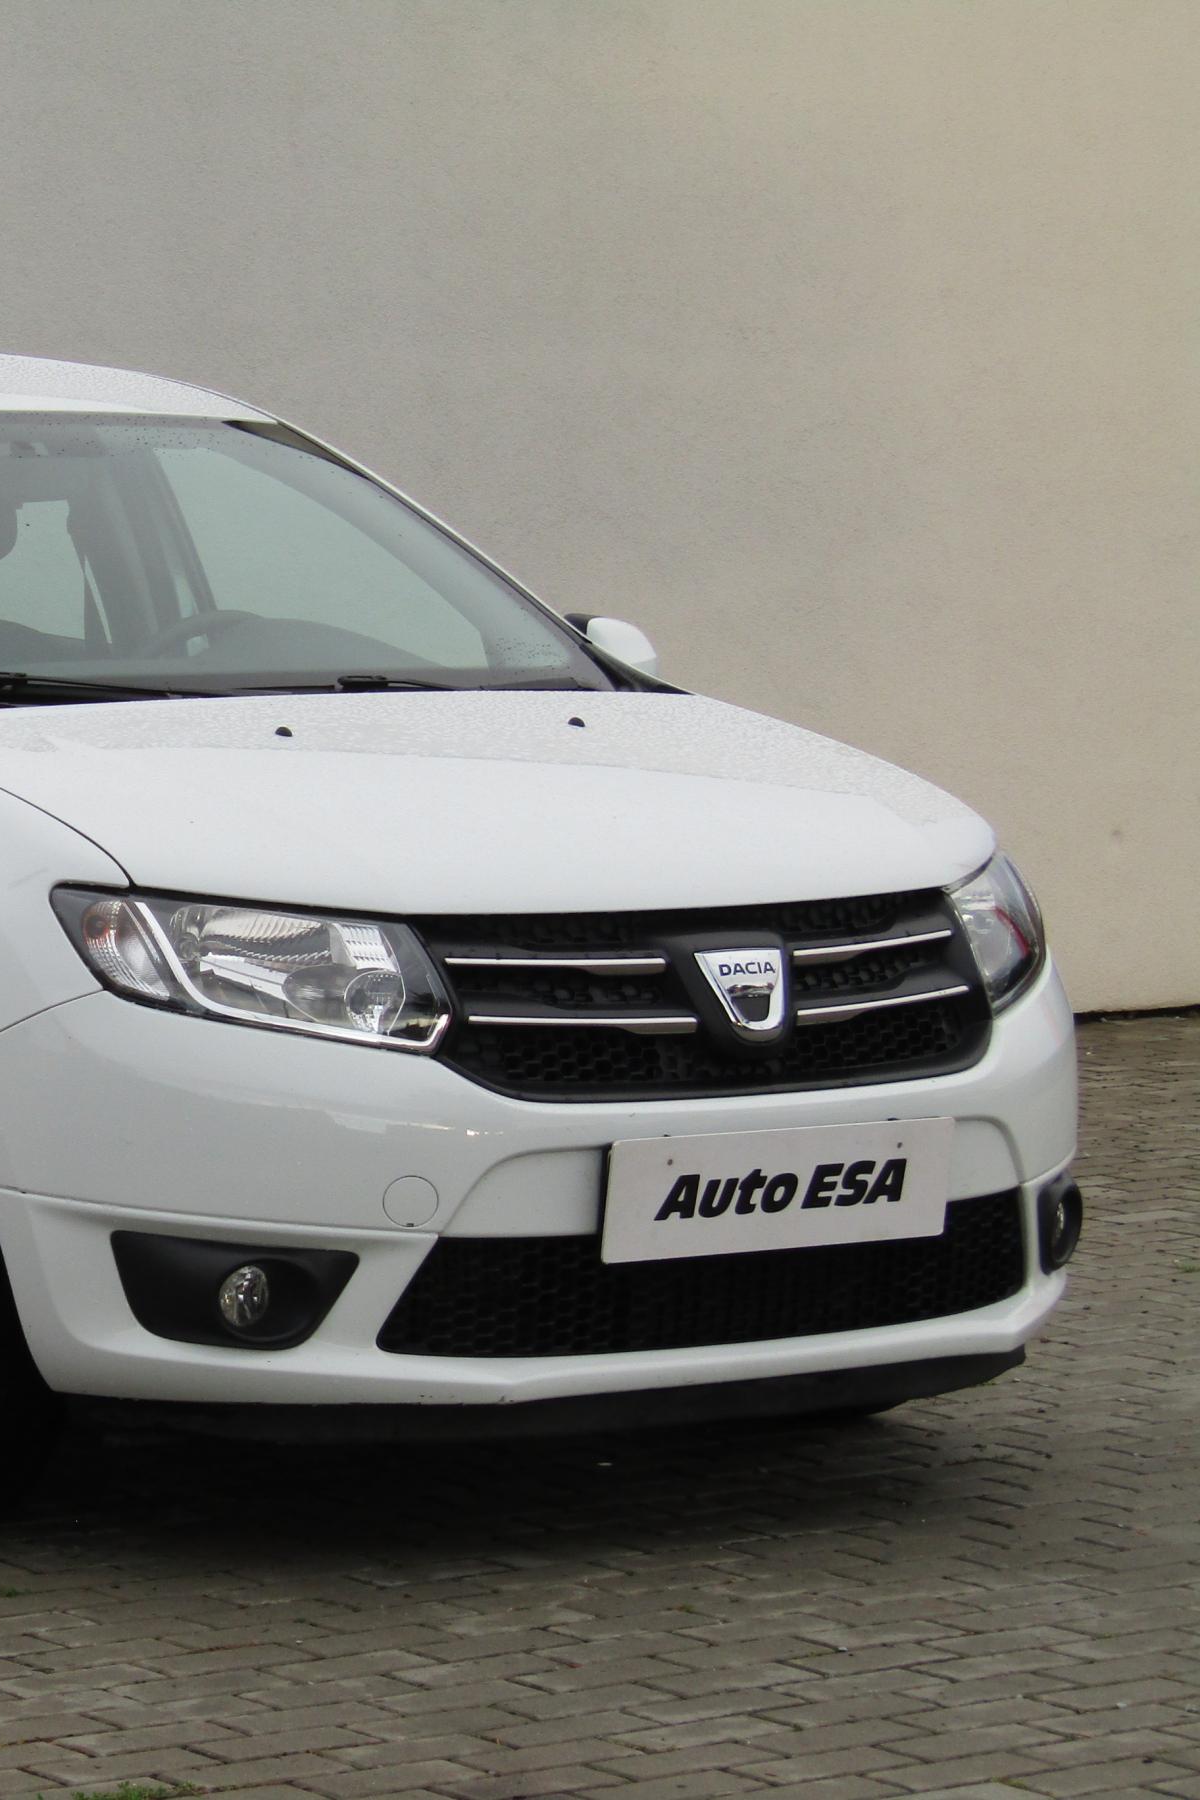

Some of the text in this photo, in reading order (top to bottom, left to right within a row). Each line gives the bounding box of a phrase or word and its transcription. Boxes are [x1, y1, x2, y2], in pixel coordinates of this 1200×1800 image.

[719, 961, 776, 976] DACIA
[654, 1158, 907, 1221] Auto ESA
